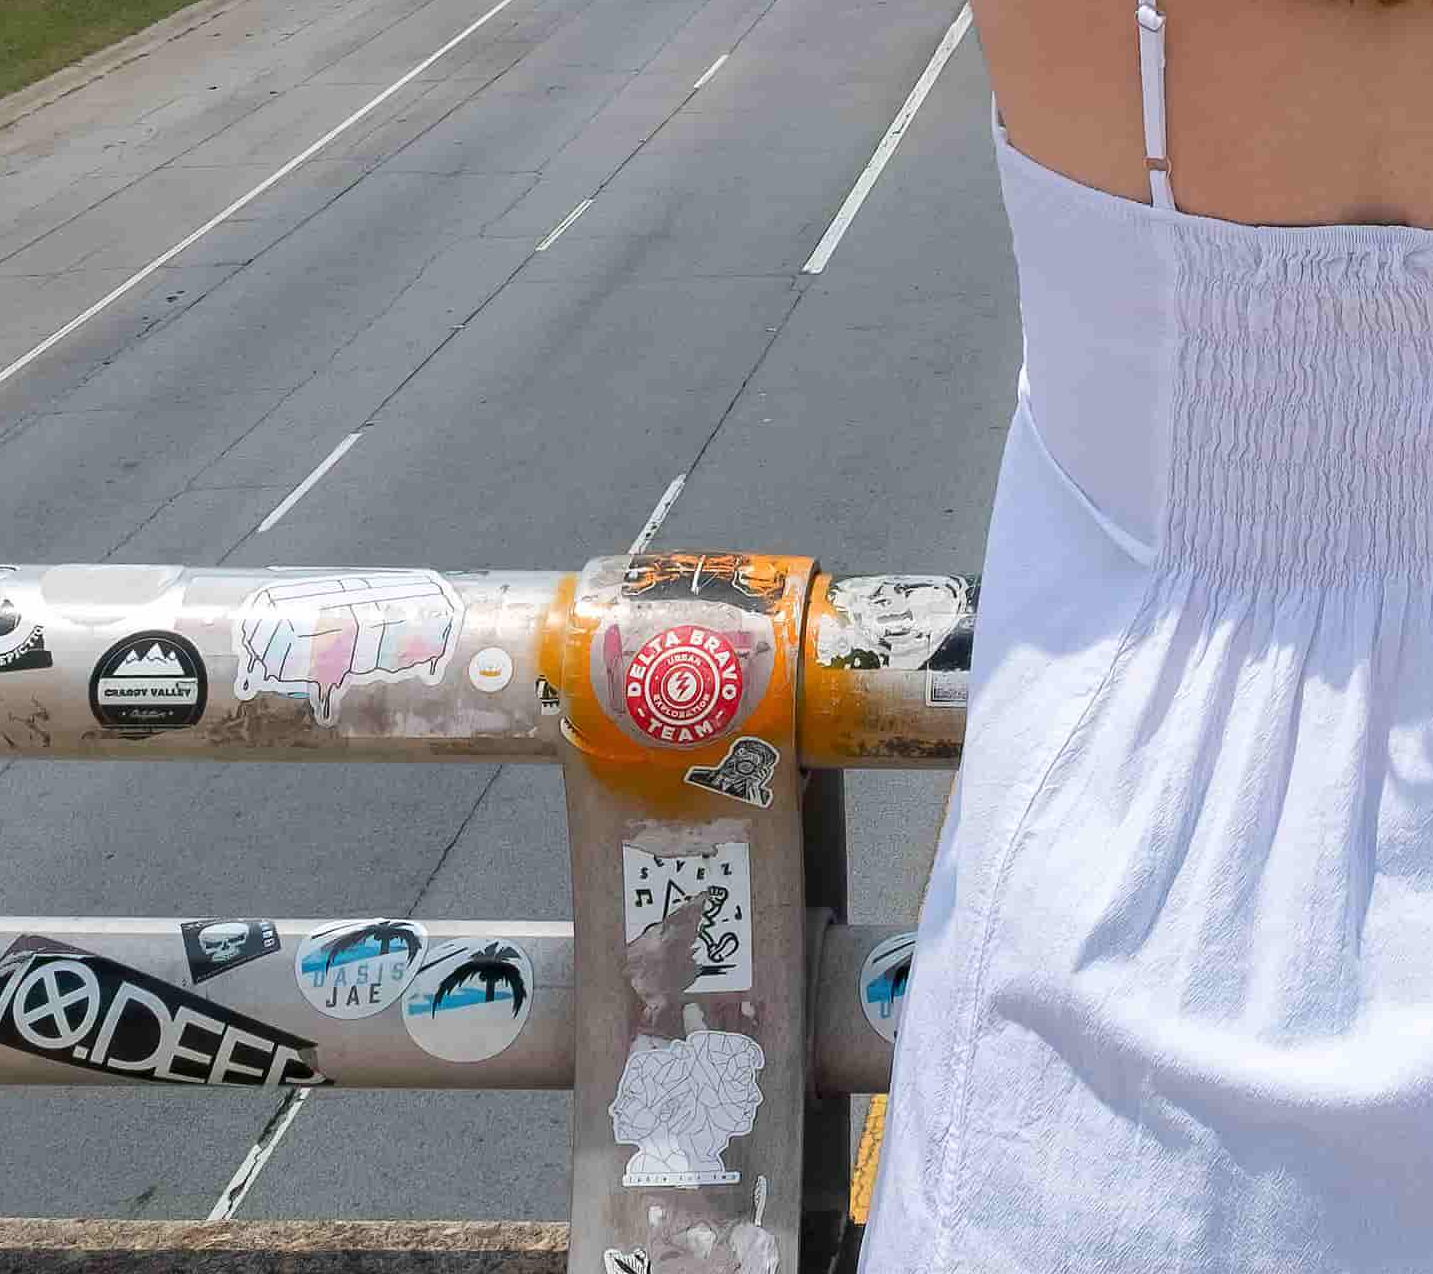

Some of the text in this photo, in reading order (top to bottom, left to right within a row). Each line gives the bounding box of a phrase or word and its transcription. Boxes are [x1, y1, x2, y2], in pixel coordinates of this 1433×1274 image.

[627, 629, 738, 700] DELTA BRAVO
[150, 687, 192, 698] VALLEY
[646, 717, 714, 743] TEAM
[325, 983, 383, 1008] JAE
